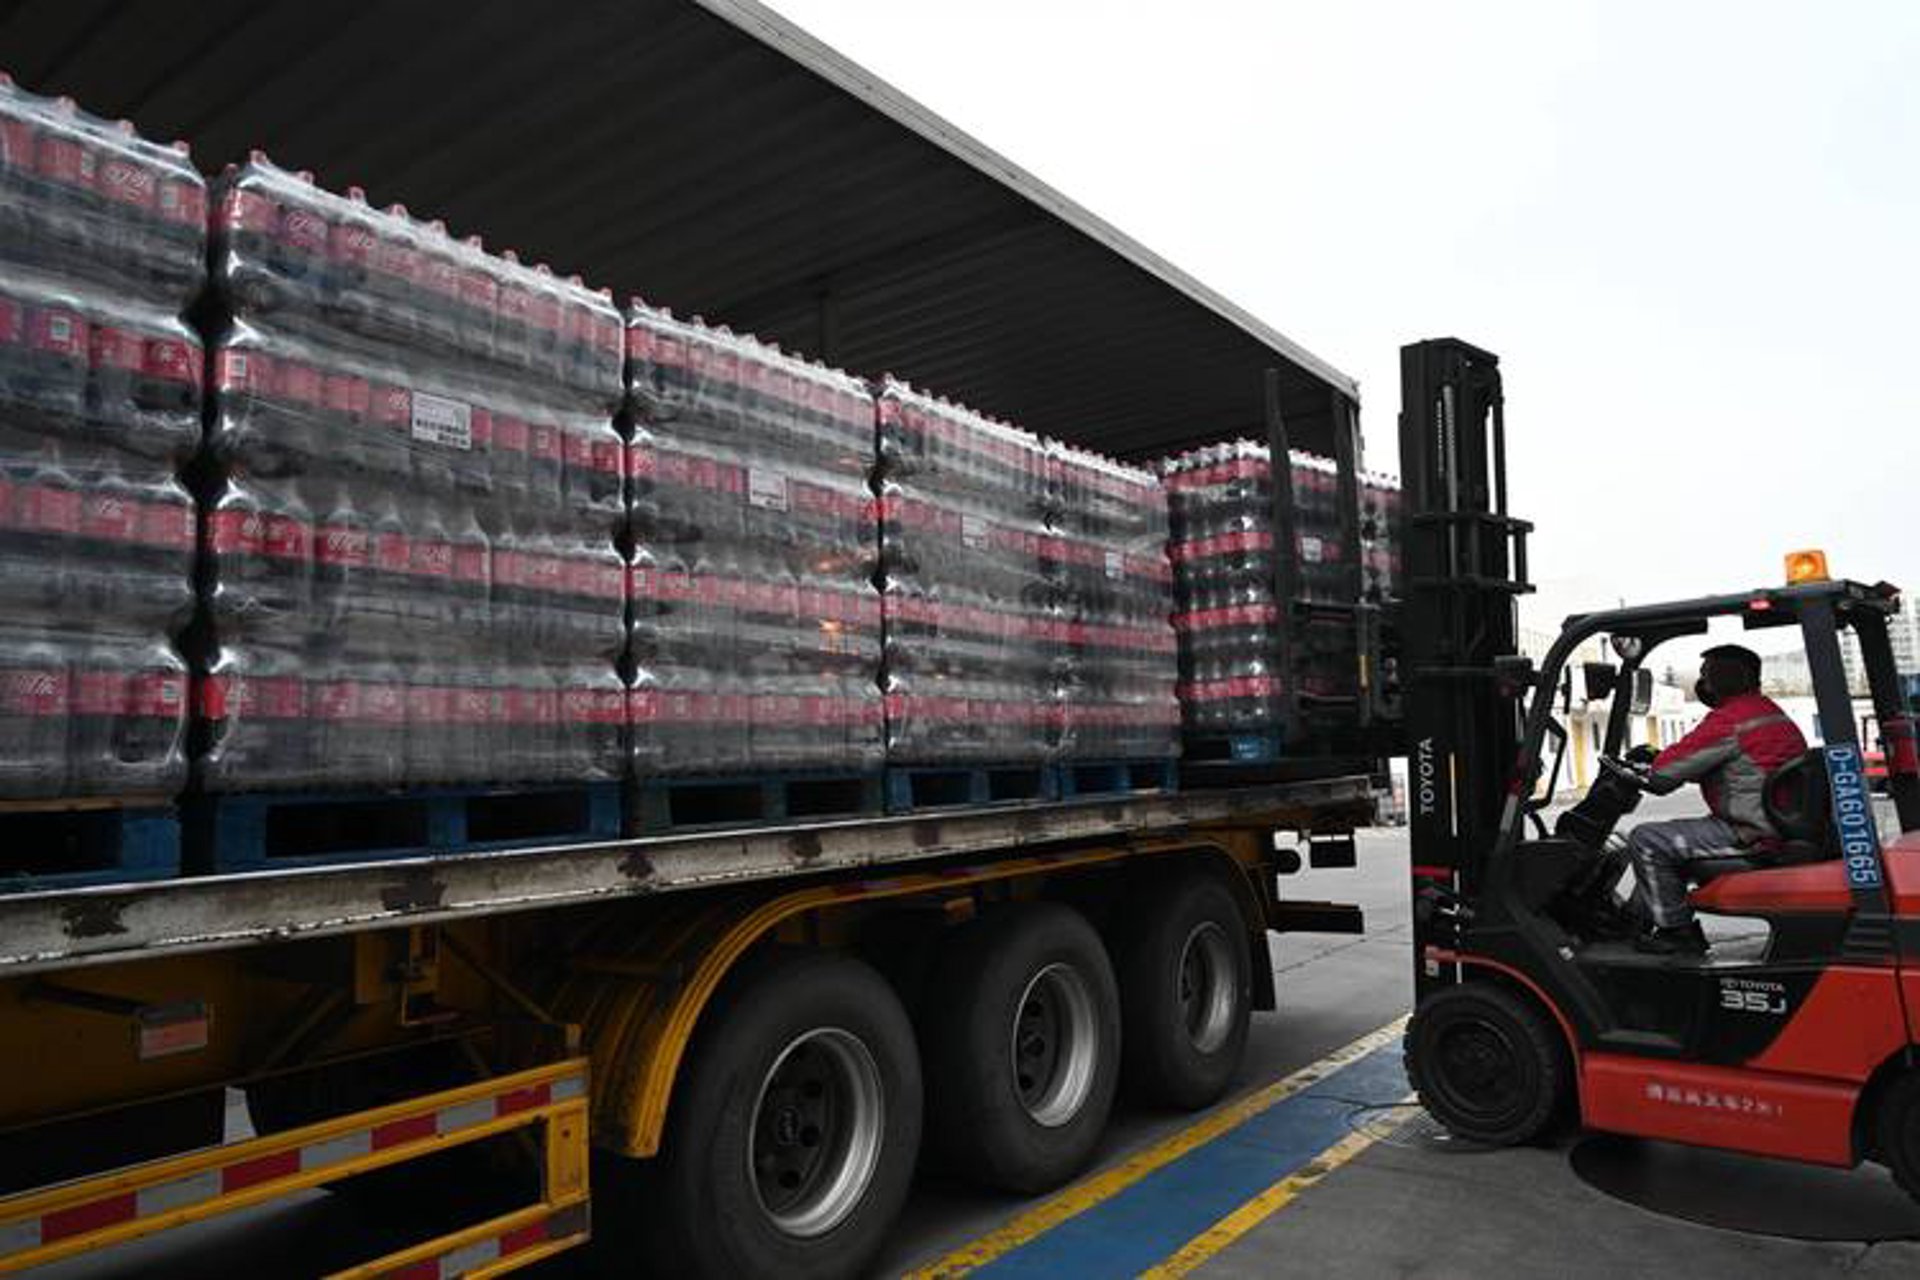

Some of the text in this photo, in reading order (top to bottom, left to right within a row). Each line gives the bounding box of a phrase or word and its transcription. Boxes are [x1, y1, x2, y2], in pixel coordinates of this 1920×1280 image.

[1419, 737, 1434, 815] TOYOTA
[1740, 980, 1786, 993] TOYOTA
[1720, 990, 1787, 1014] 35J
